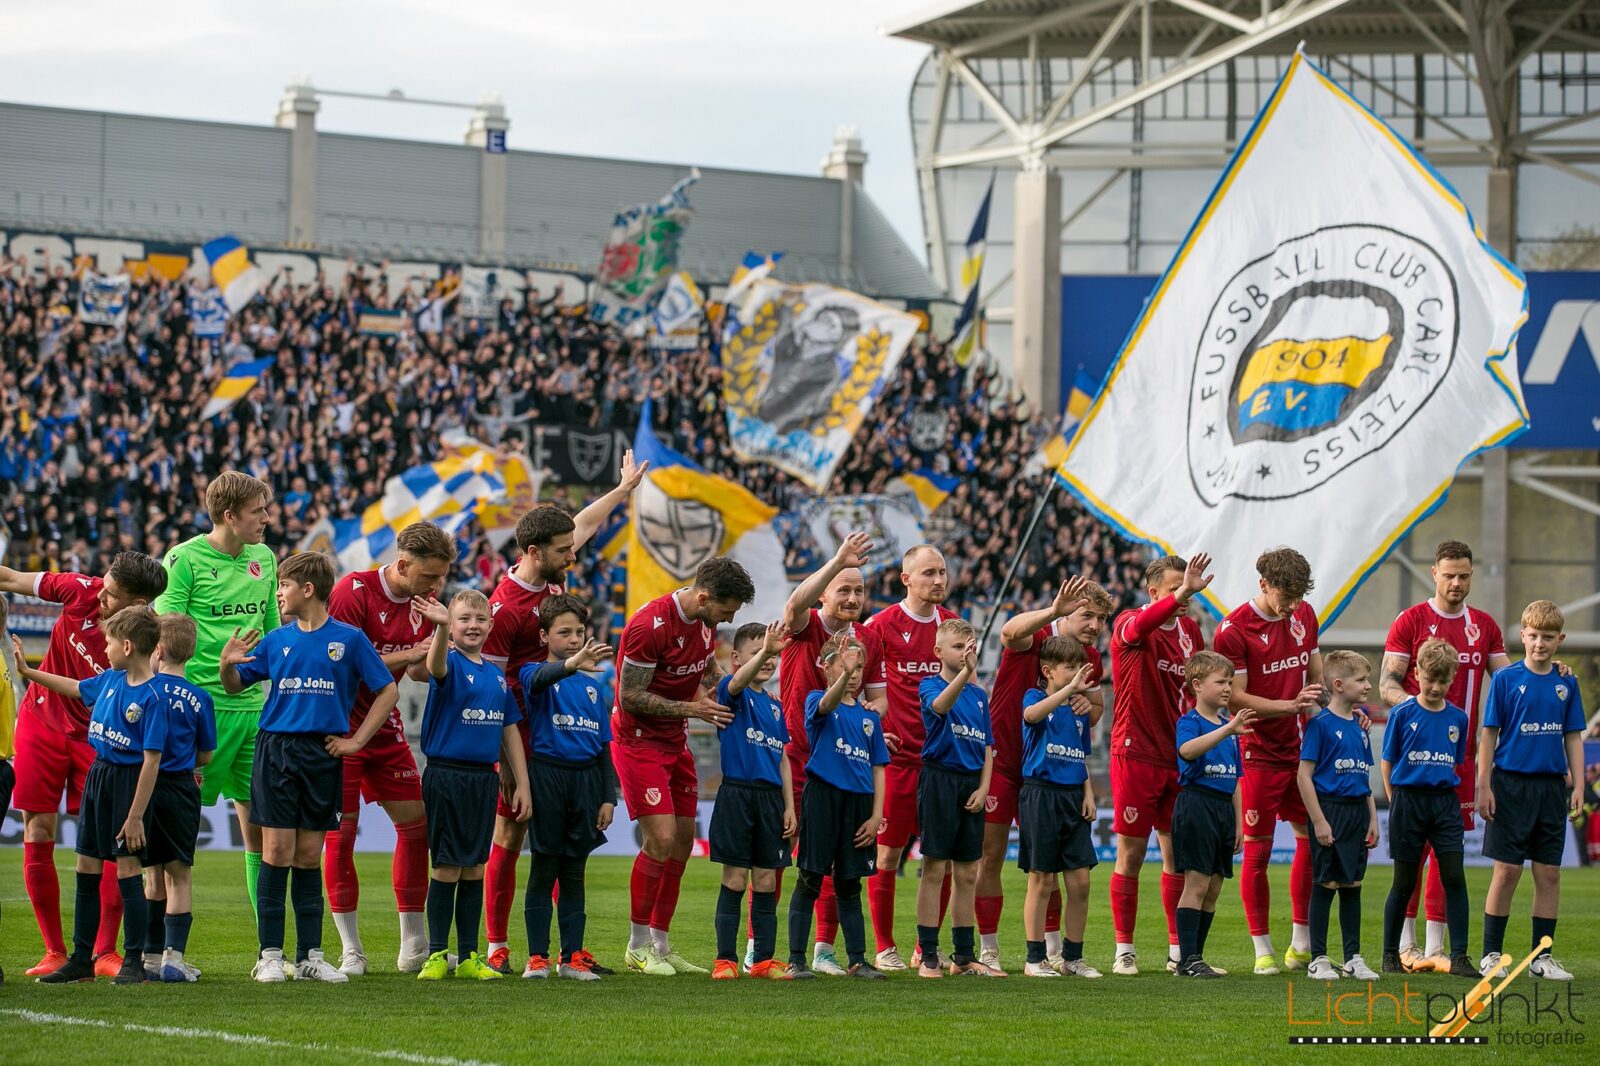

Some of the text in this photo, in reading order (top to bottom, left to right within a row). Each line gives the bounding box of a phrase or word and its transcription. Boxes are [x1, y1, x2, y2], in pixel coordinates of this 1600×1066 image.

[1354, 243, 1427, 288] CLUB
[1303, 393, 1406, 475] ZEISS
[1157, 659, 1186, 676] EAG
[304, 677, 334, 689] John
[172, 685, 202, 713] ZEISS
[577, 716, 599, 730] John
[105, 726, 131, 746] John
[766, 735, 783, 749] ohn
